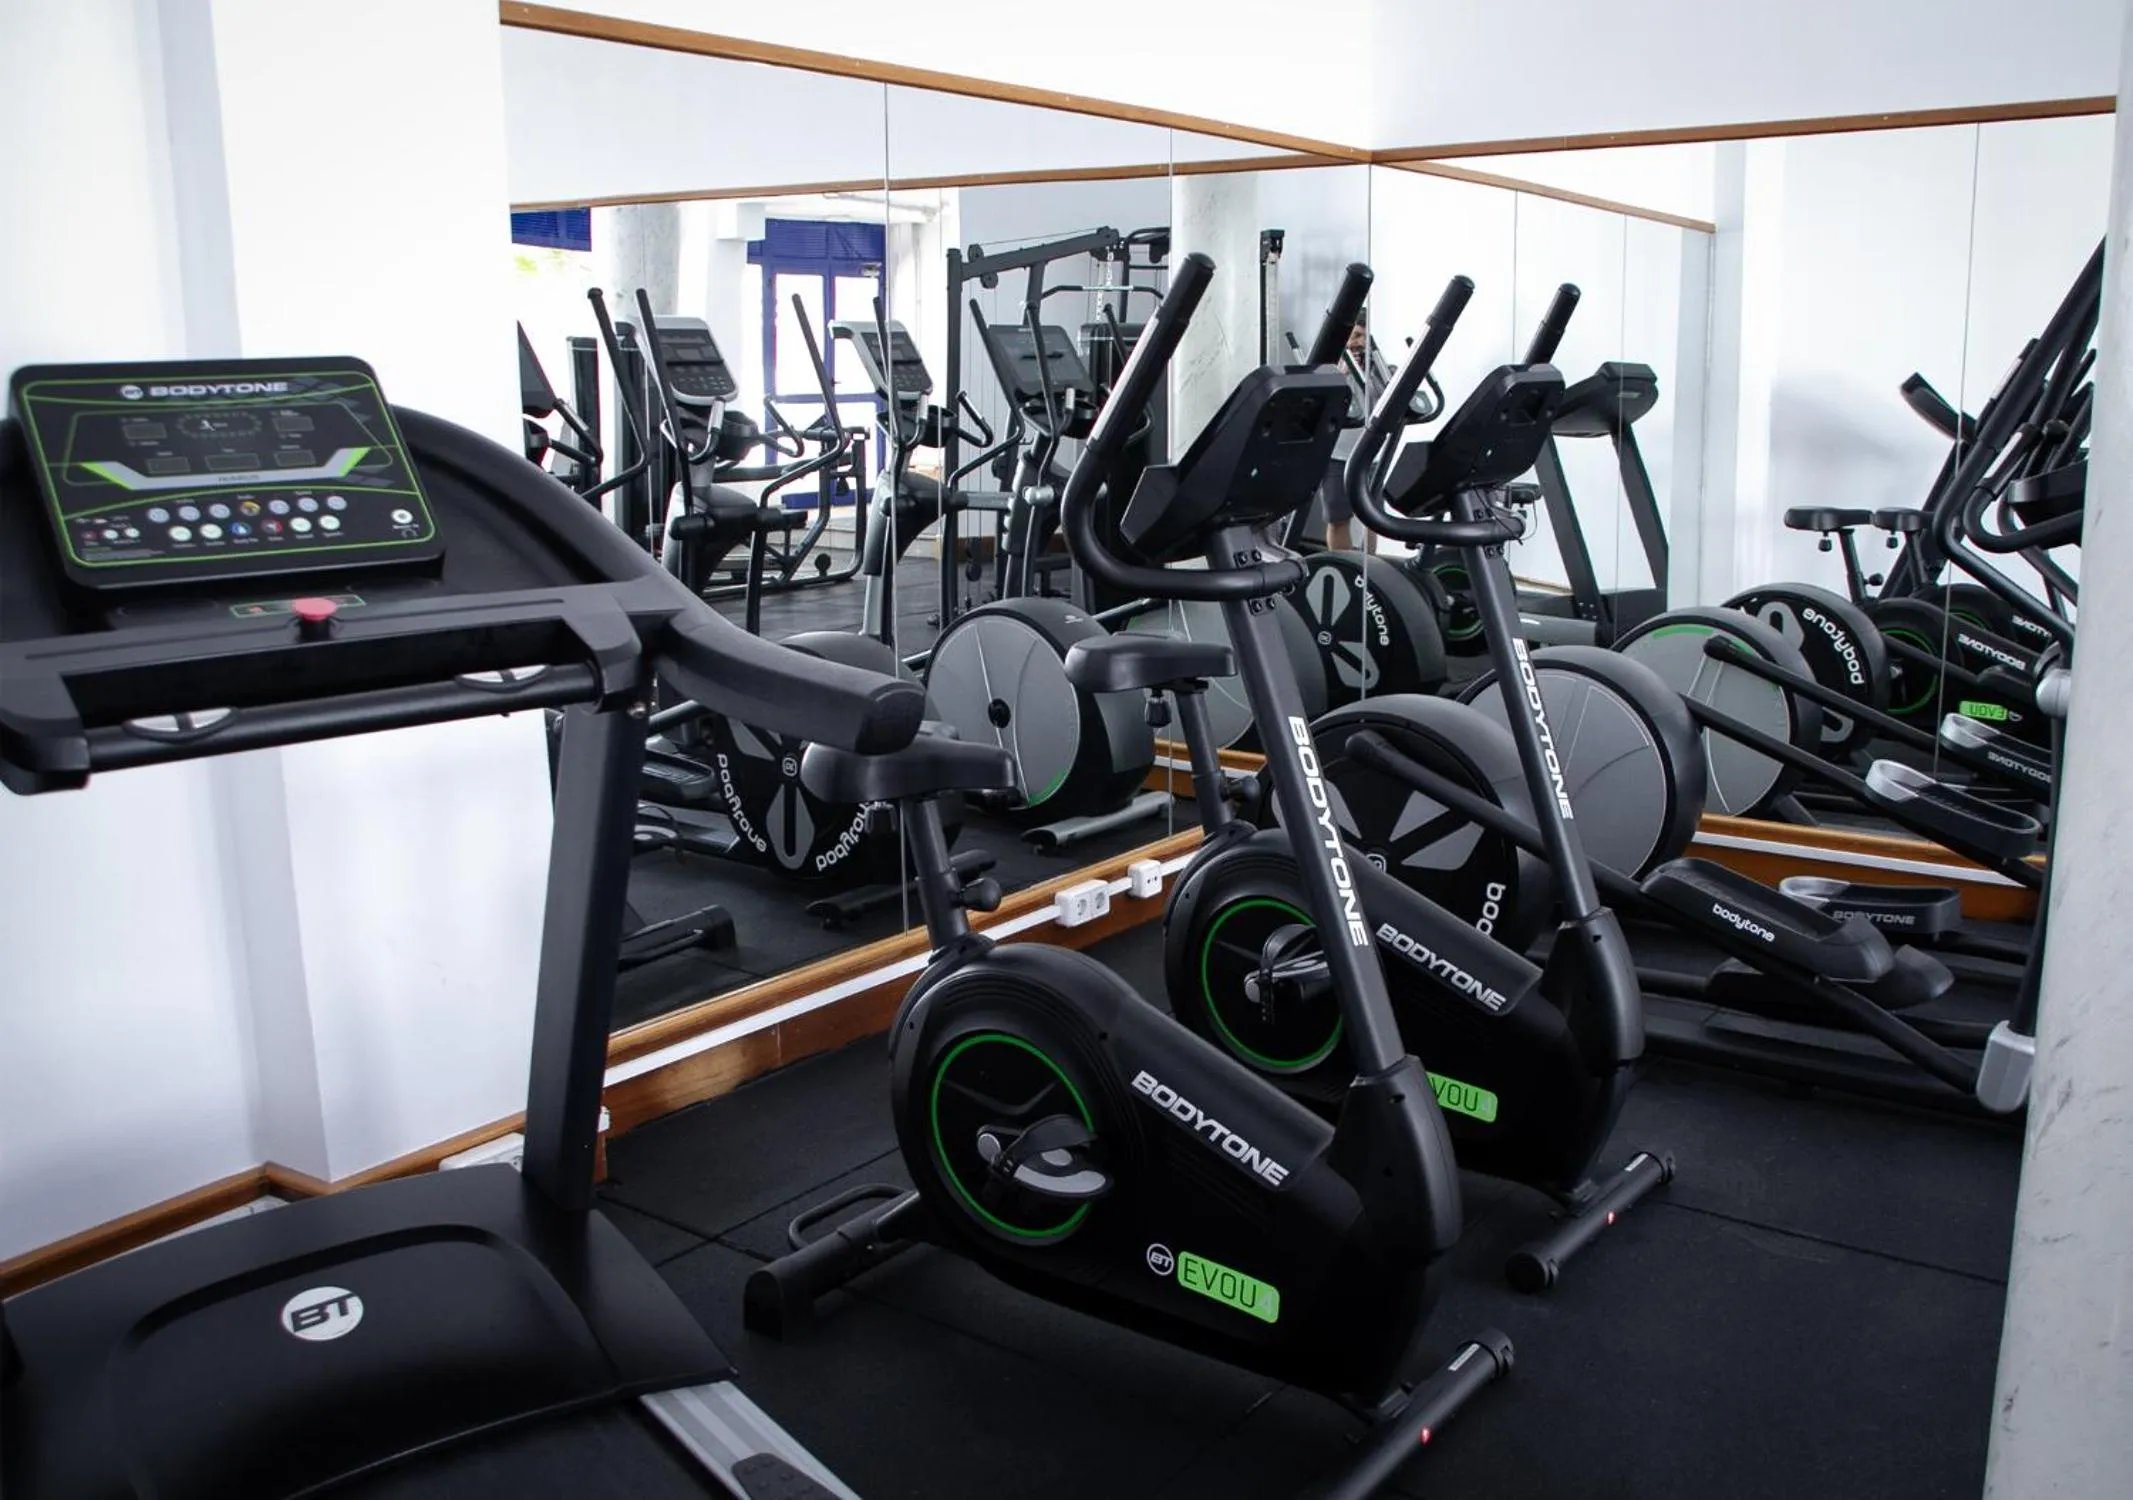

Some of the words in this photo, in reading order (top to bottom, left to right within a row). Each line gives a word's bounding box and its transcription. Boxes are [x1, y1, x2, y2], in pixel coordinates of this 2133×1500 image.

[150, 382, 288, 397] BODYTONE
[1354, 574, 1390, 647] bdytone
[1513, 637, 1574, 820] BODYTONE
[1288, 716, 1369, 947] BODYTONE
[1713, 903, 1775, 942] bodytone
[1376, 922, 1507, 1012] BODYTONE
[1131, 1070, 1289, 1187] BODYTONE
[290, 1292, 357, 1333] BT
